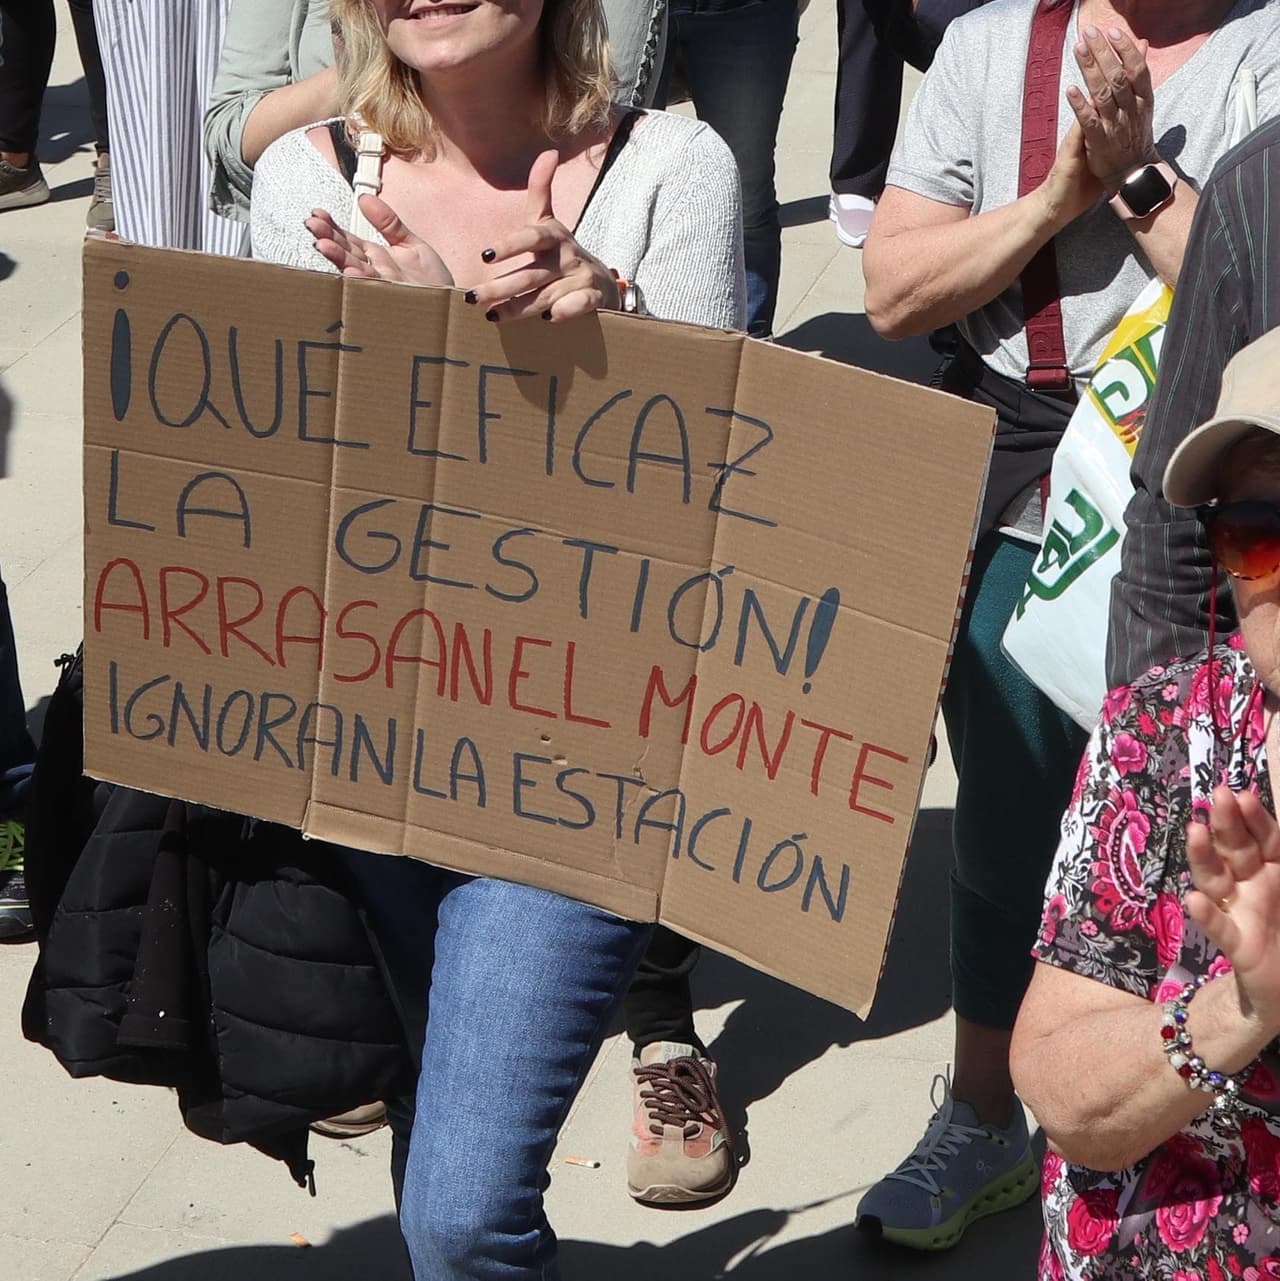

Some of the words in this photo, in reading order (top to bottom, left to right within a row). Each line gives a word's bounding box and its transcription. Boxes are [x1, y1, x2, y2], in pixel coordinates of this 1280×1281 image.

[110, 270, 370, 450] ¡QUÉ
[408, 355, 778, 528] EFICAZ
[108, 449, 252, 549] LA
[336, 498, 840, 695] GESTIÓN!
[109, 660, 397, 786] IGNORAN
[412, 728, 487, 808] LA
[512, 752, 850, 923] ESTACIÓN
[639, 665, 909, 825] MONTE
